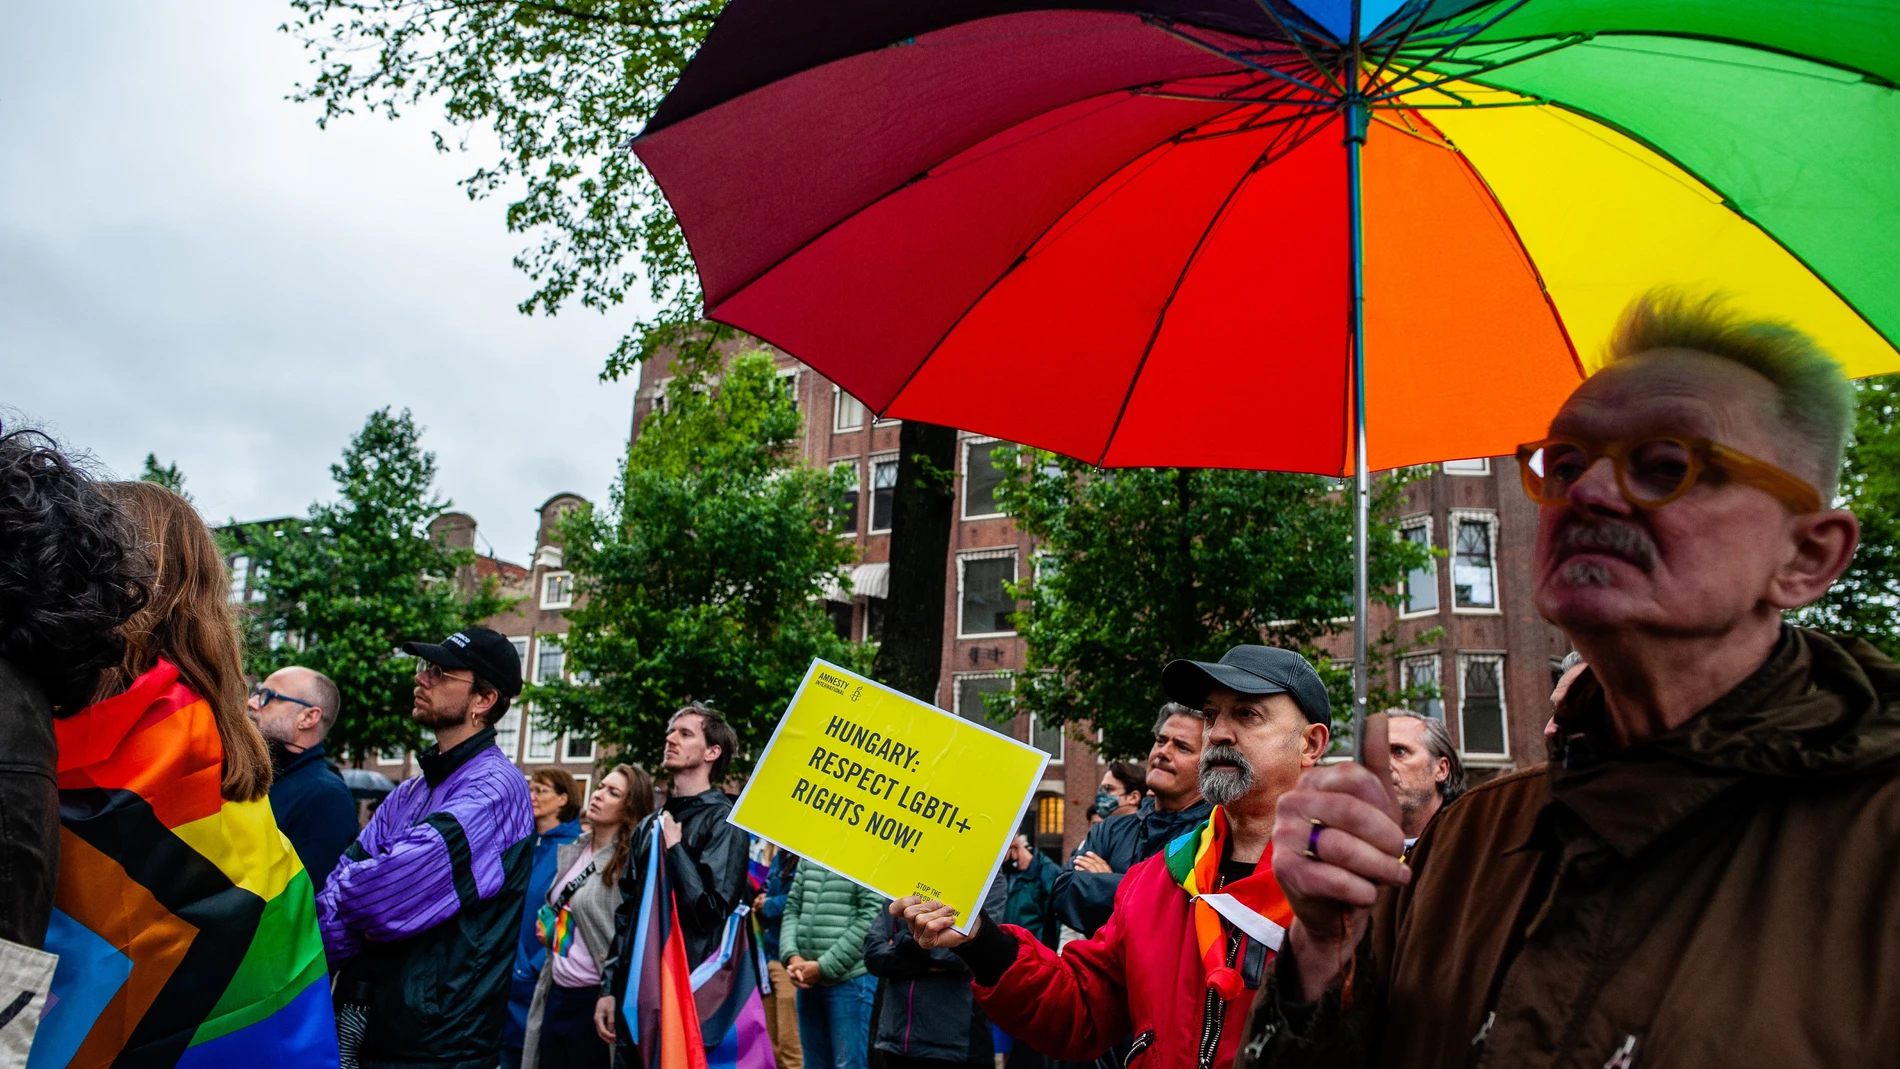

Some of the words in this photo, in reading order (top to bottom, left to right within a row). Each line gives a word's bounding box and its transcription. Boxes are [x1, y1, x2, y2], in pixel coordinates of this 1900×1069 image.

[815, 680, 845, 696] INTERNATIONAL
[818, 672, 850, 690] AMNESTY
[824, 715, 920, 773] HUNGARY:
[808, 746, 900, 801] RESPECT
[897, 785, 971, 834] LGBTI+
[791, 777, 865, 826] RIGHTS
[864, 811, 924, 853] NOW!
[916, 882, 931, 892] STOP
[930, 888, 941, 898] THE
